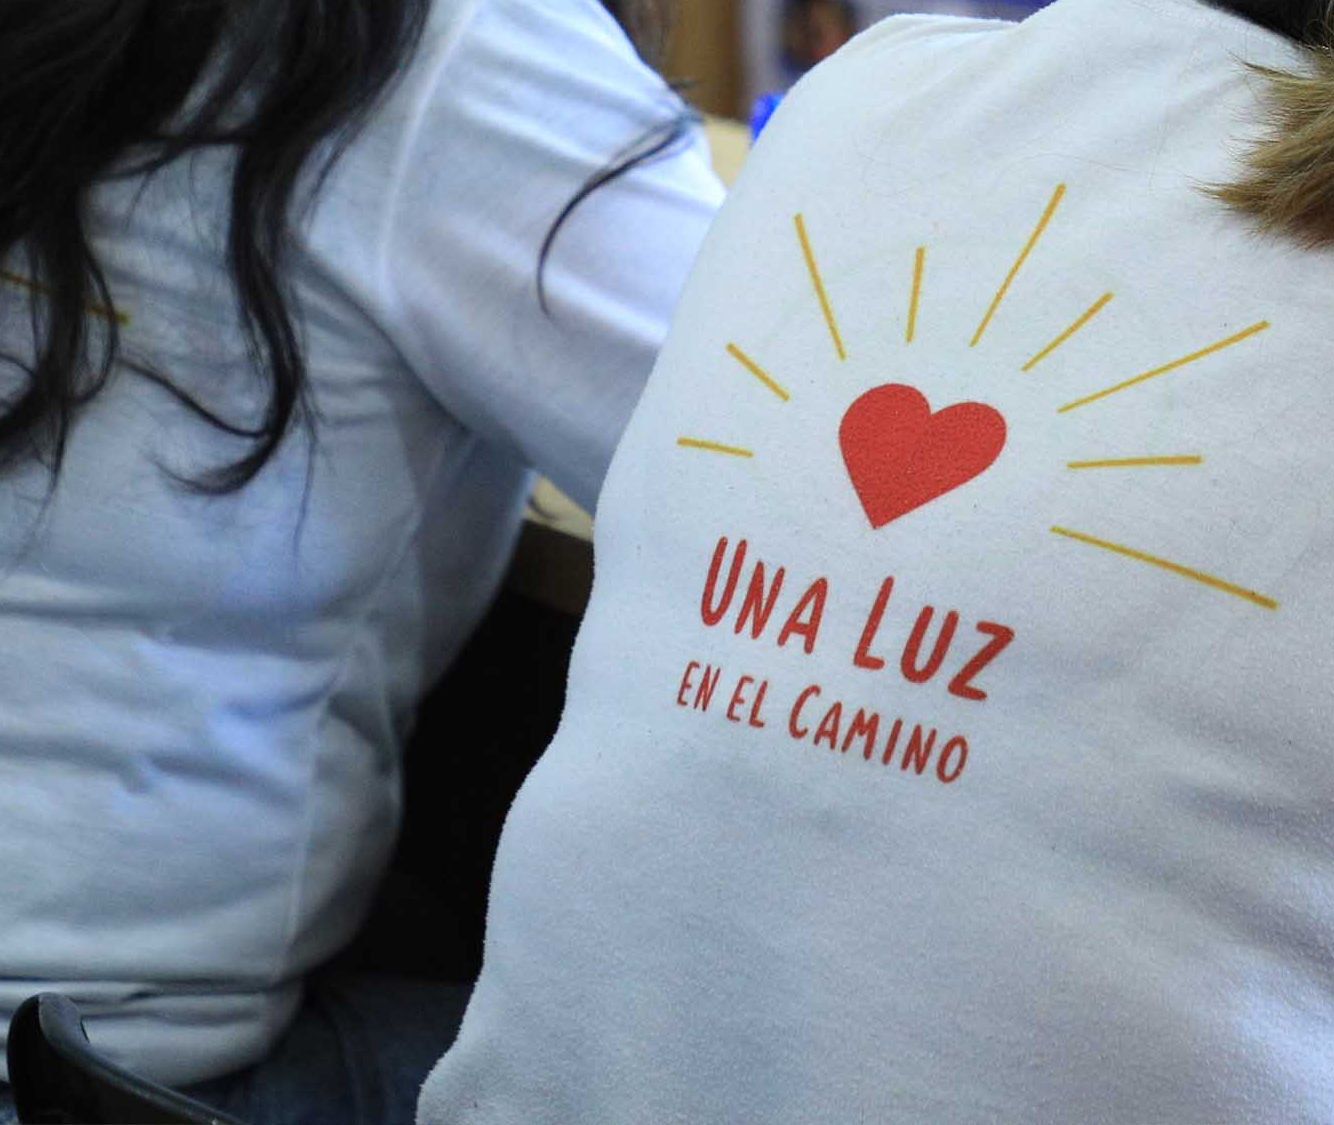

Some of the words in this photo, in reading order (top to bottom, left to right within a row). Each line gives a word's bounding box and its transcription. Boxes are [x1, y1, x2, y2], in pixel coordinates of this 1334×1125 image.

[700, 536, 829, 655] UNA
[853, 575, 1015, 701] LUZ
[677, 661, 720, 711] EN
[726, 675, 769, 729] EL
[788, 684, 968, 784] CAMINO
